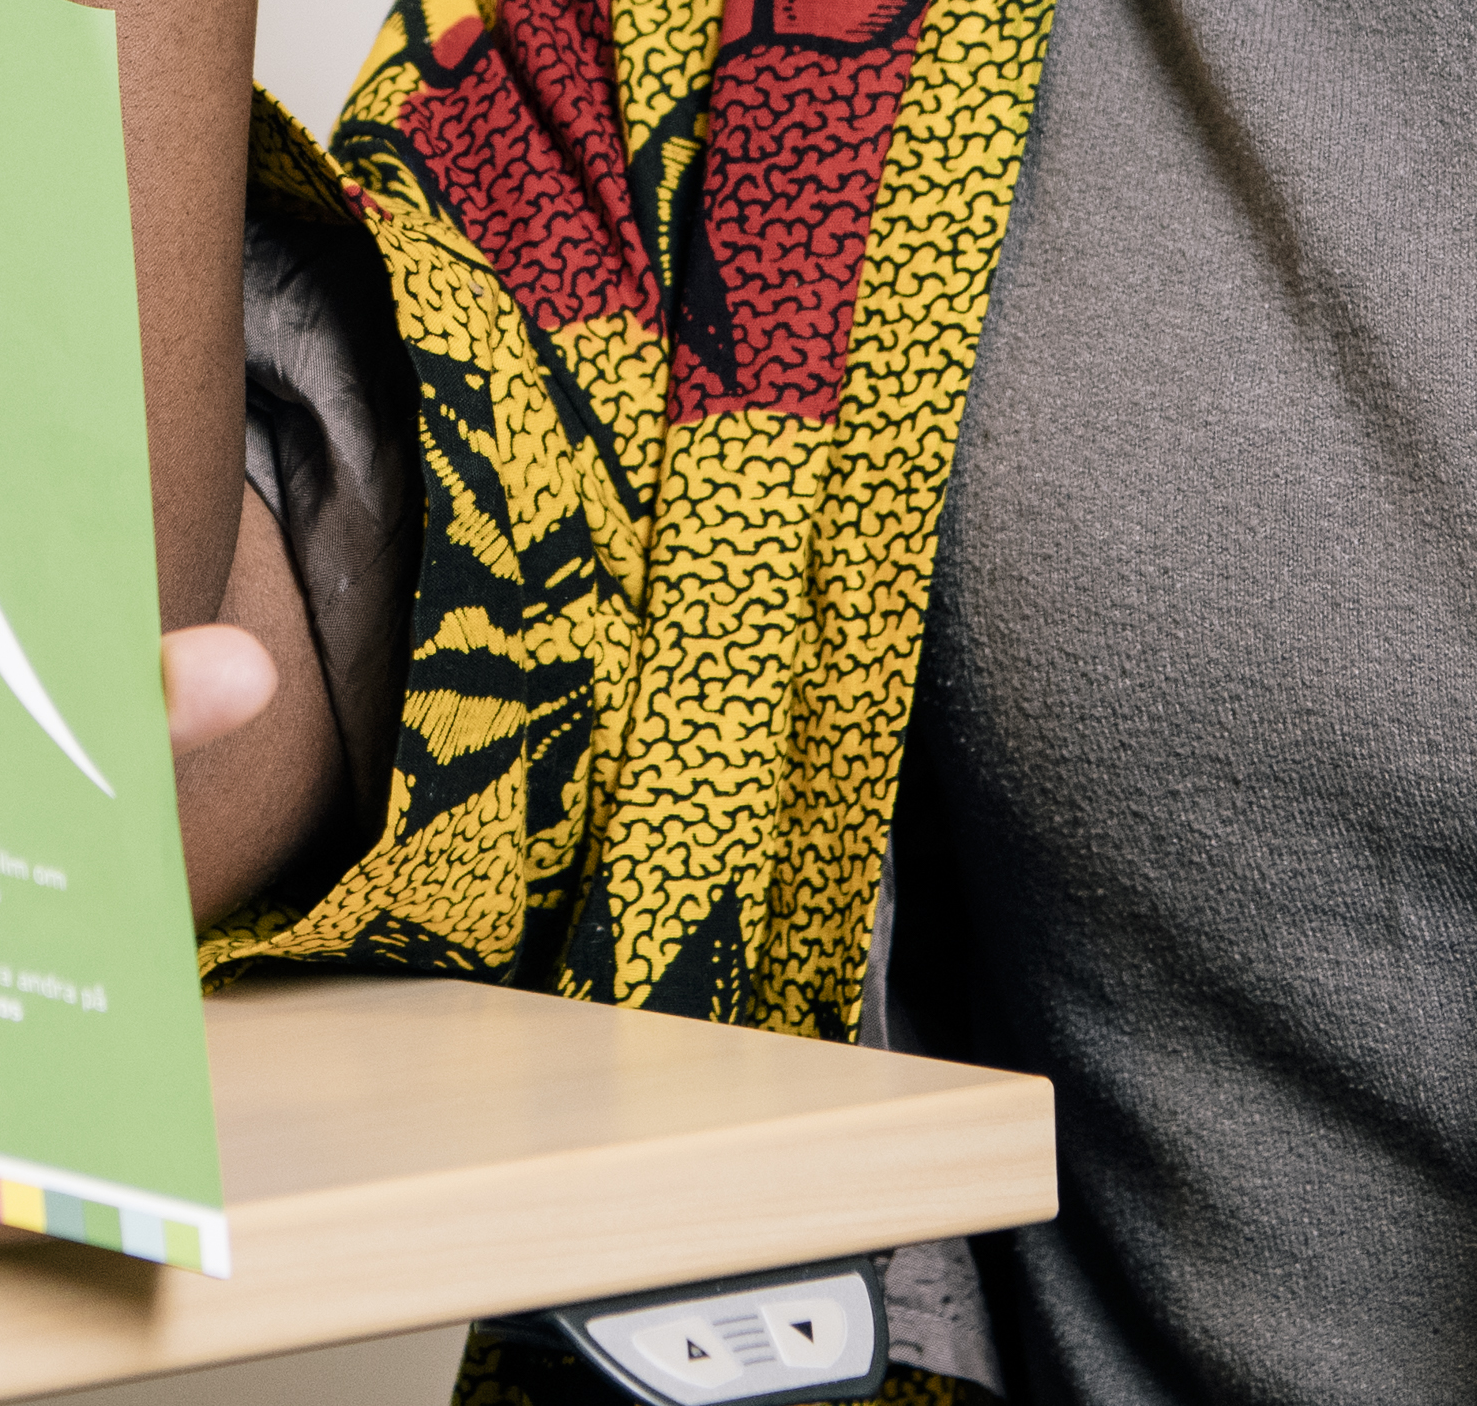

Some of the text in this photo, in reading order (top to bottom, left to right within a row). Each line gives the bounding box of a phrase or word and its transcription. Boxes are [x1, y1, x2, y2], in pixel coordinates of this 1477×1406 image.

[32, 864, 68, 892] om
[16, 972, 78, 1005] andra
[81, 983, 108, 1013] på
